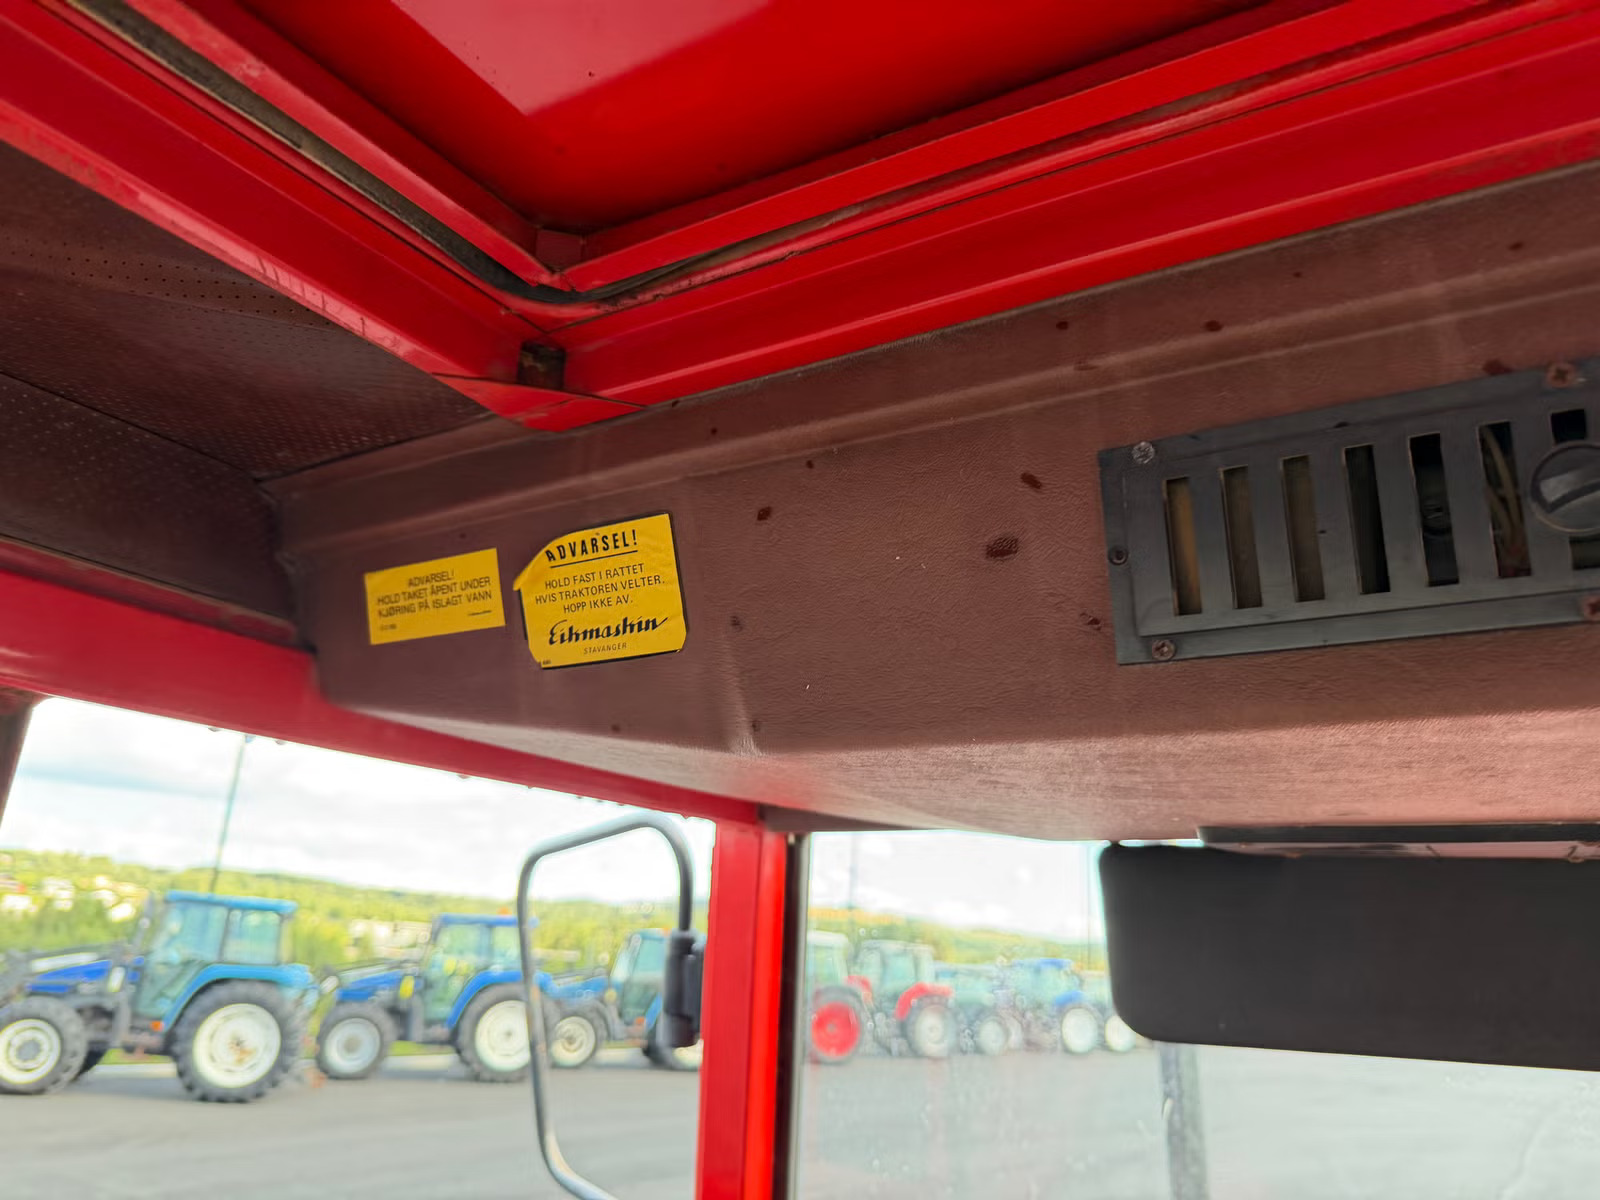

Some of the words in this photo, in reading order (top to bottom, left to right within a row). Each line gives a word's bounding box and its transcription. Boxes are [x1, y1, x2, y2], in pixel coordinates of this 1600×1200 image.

[545, 529, 638, 562] ADVARSEL!
[535, 592, 558, 604] HVIS
[558, 583, 618, 600] TRAKTOREN
[621, 574, 665, 590] VELTER.
[544, 576, 571, 589] HOLD
[574, 572, 596, 584] FAST
[606, 563, 645, 579] RATTET
[378, 592, 400, 606] HOLD
[402, 588, 428, 601] TAKET
[430, 582, 458, 597] ÅPENT
[460, 576, 491, 591] UNDER
[378, 603, 416, 618] KJØRING
[418, 599, 430, 610] PÅ
[432, 594, 462, 608] ISLAGT
[466, 590, 492, 603] VANN
[563, 601, 587, 614] HOPP
[590, 597, 612, 610] IKKE
[616, 594, 634, 606] AV.
[584, 642, 628, 655] STAVANGER
